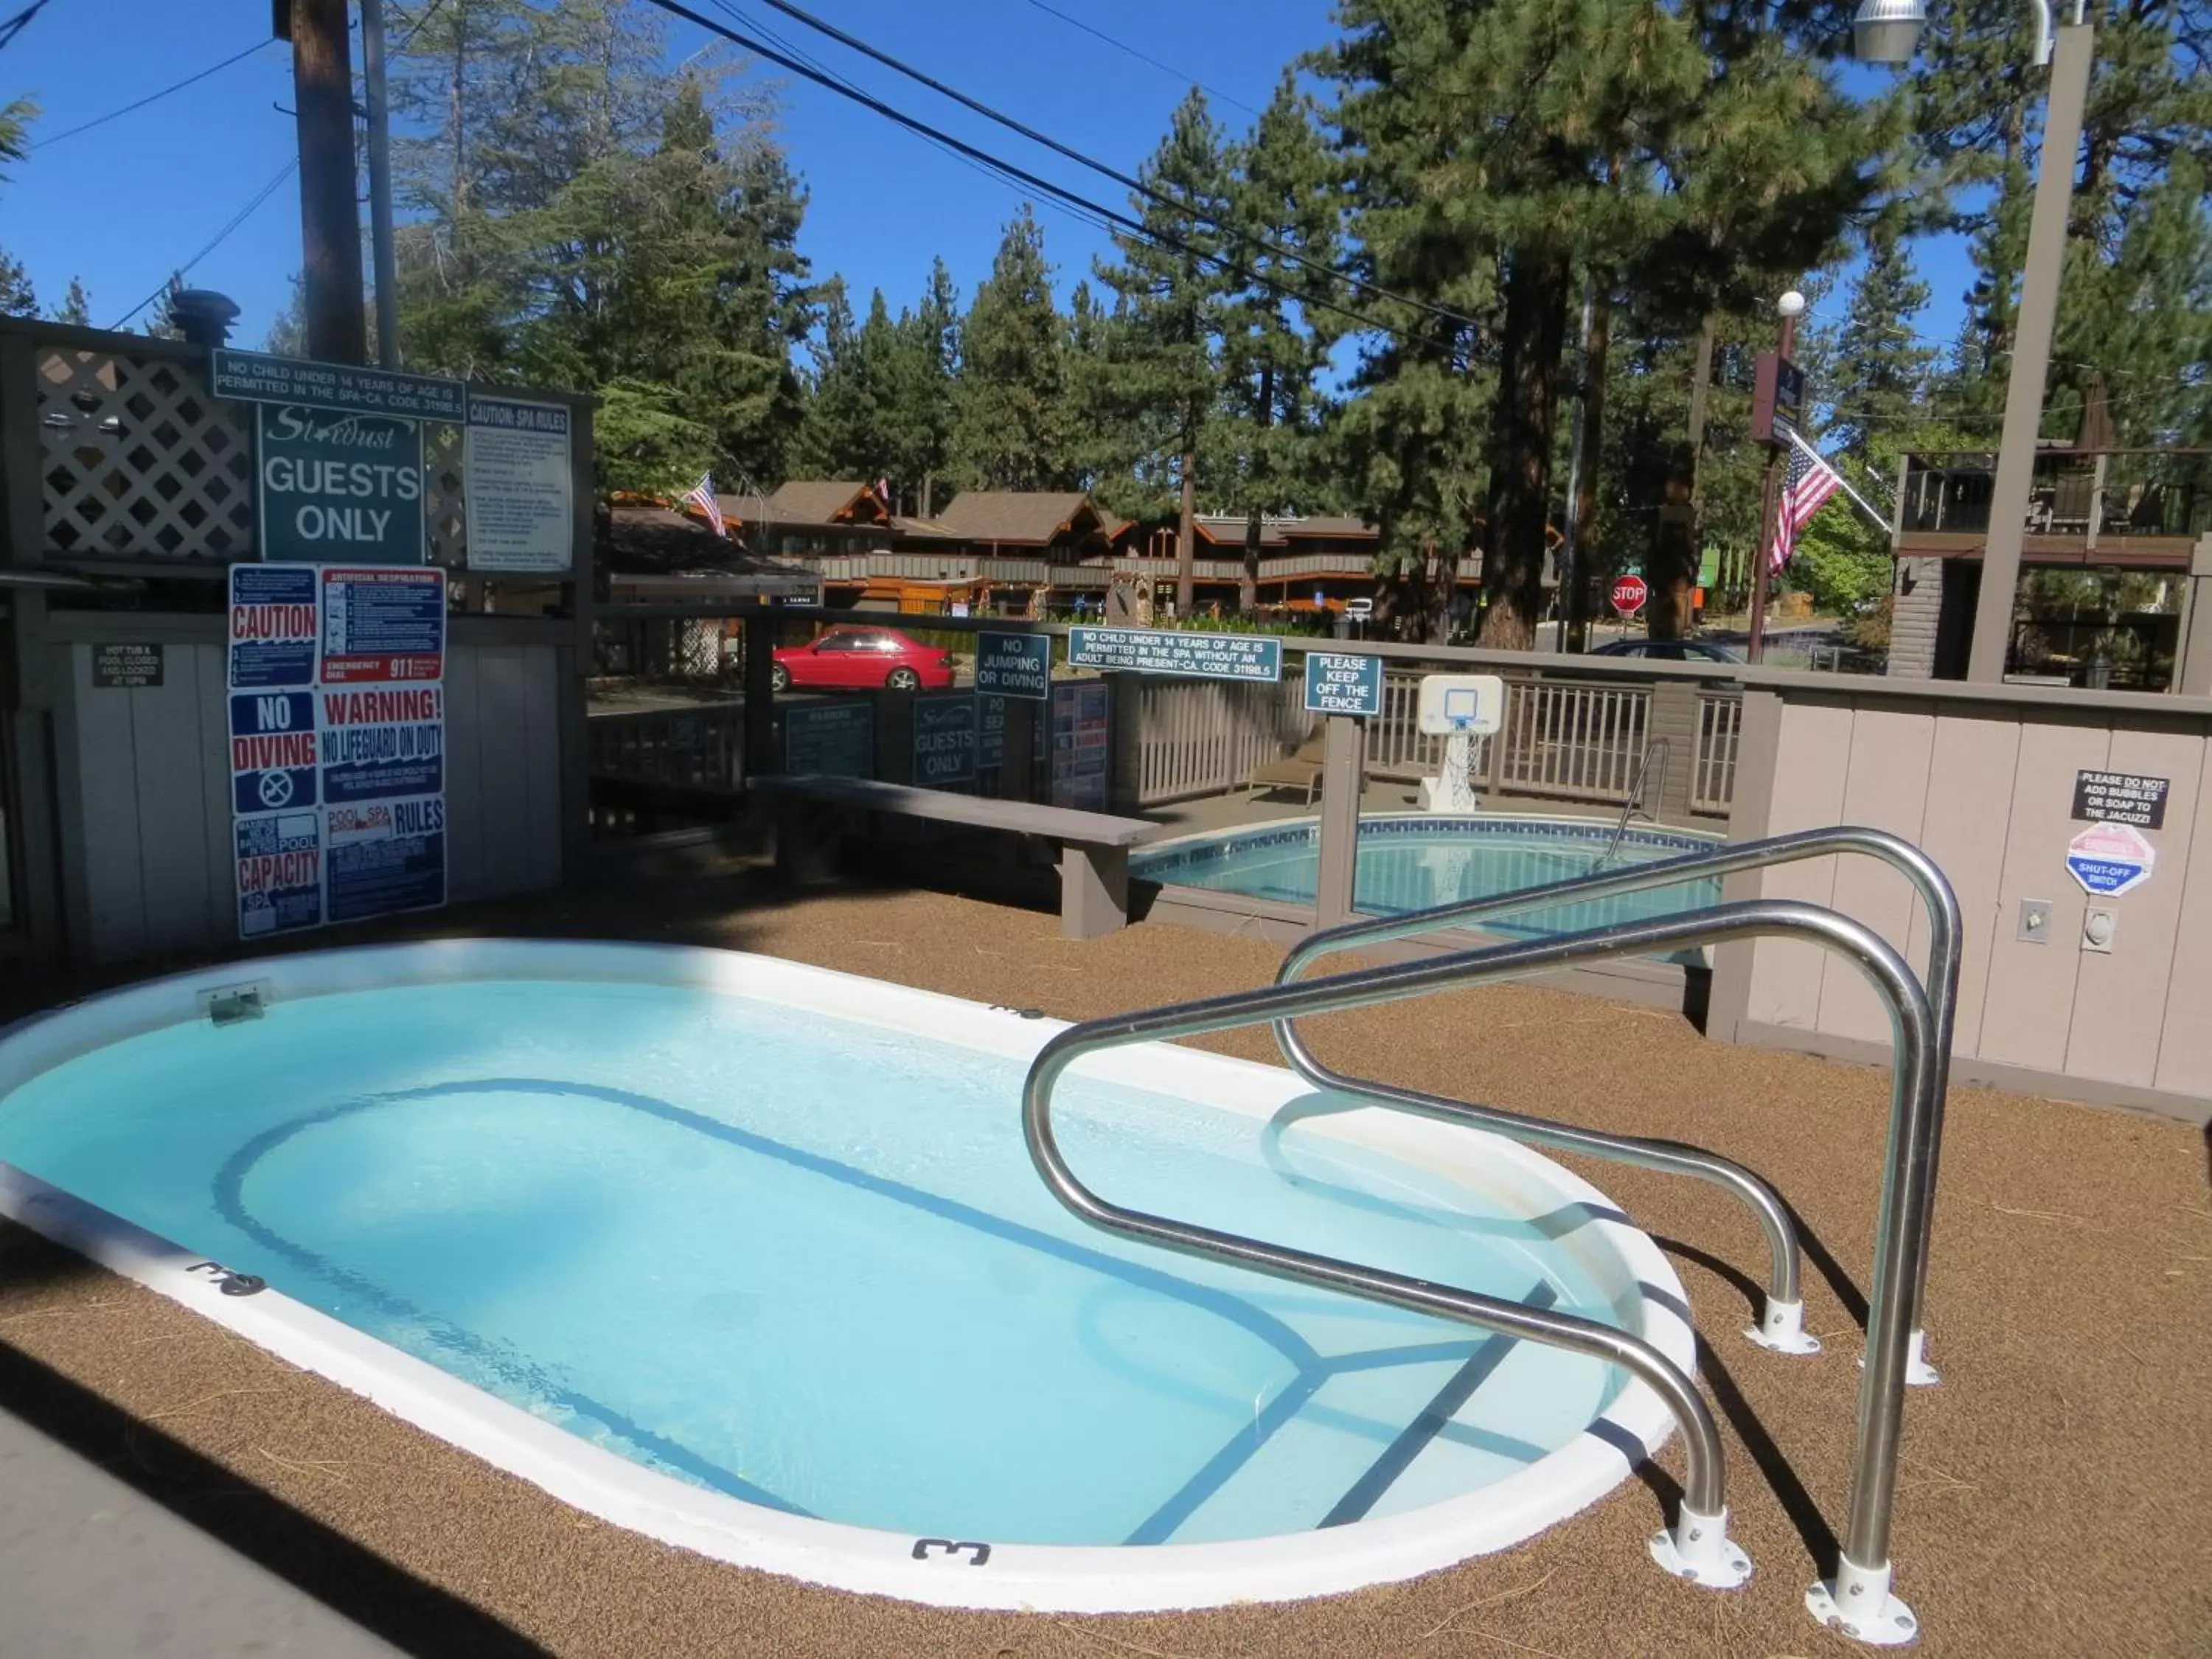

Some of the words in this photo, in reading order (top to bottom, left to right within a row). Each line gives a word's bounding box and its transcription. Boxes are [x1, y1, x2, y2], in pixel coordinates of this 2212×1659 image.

[228, 361, 246, 375] NO
[252, 363, 290, 380] CHILD
[295, 369, 335, 385] UNDER
[341, 375, 352, 388] 14
[358, 377, 394, 393] YEARS
[399, 383, 414, 395] OF
[417, 385, 439, 400] AGE
[442, 389, 453, 400] IS
[218, 375, 288, 393] PERMITTED
[293, 383, 306, 395] IN
[312, 385, 334, 400] THE
[389, 396, 419, 410] CODE
[517, 409, 535, 428] SPA
[536, 411, 566, 432] RULES
[265, 455, 420, 501] GUESTS
[295, 505, 392, 542] ONLY
[1613, 586, 1644, 599] STOP
[232, 605, 316, 639] CAUTION
[1003, 639, 1023, 653] NO
[1082, 632, 1097, 642] NO
[1099, 633, 1126, 644] CHILD
[1129, 636, 1162, 646] UNDER
[1164, 637, 1175, 647] 14
[1178, 638, 1209, 649] YEARS
[1214, 639, 1226, 650] OF
[1229, 641, 1251, 651] AGE
[1253, 642, 1264, 652] IS
[1075, 653, 1101, 663] ADULT
[1105, 655, 1133, 666] BEING
[1203, 661, 1230, 672] CODE
[1085, 643, 1135, 654] PERMITTED
[1138, 645, 1150, 655] IN
[1152, 646, 1170, 656] THE
[1173, 647, 1192, 658] SPA
[1194, 650, 1238, 662] WITHOUT
[1242, 652, 1256, 663] AN
[327, 661, 381, 671] EMERGENCY
[390, 658, 413, 678] 911
[983, 655, 1040, 672] JUMPING
[1319, 657, 1368, 670] PLEASE
[978, 671, 1000, 685] OR
[1002, 673, 1045, 689] DIVING
[1326, 670, 1360, 684] KEEP
[1316, 683, 1340, 695] OFF
[1345, 684, 1369, 697] THE
[323, 689, 442, 725] WARNING!
[1321, 696, 1363, 709] FENCE
[256, 695, 291, 731] NO
[322, 731, 338, 762] NO
[340, 727, 396, 759] LIFEGUARD
[400, 726, 414, 755] ON
[417, 723, 442, 755] DUTY
[915, 728, 974, 754] GUESTS
[232, 733, 316, 771] DIVING
[925, 753, 964, 776] ONLY
[2082, 772, 2122, 785] PLEASE
[2124, 777, 2140, 788] DO
[2143, 780, 2165, 792] NOT
[2084, 785, 2107, 795] ADD
[2109, 787, 2158, 801] BUBBLES
[2085, 807, 2105, 818] THE
[2087, 797, 2103, 807] OR
[2105, 799, 2135, 810] SOAP
[2137, 802, 2151, 813] TO
[328, 808, 358, 825] POOL
[368, 805, 390, 823] SPA
[394, 799, 443, 835] RULES
[278, 834, 319, 852] POOL
[238, 849, 319, 892] CAPACITY
[2079, 862, 2132, 877] SHUT-OFF
[246, 893, 272, 911] SPA
[911, 1539, 992, 1566] 3
